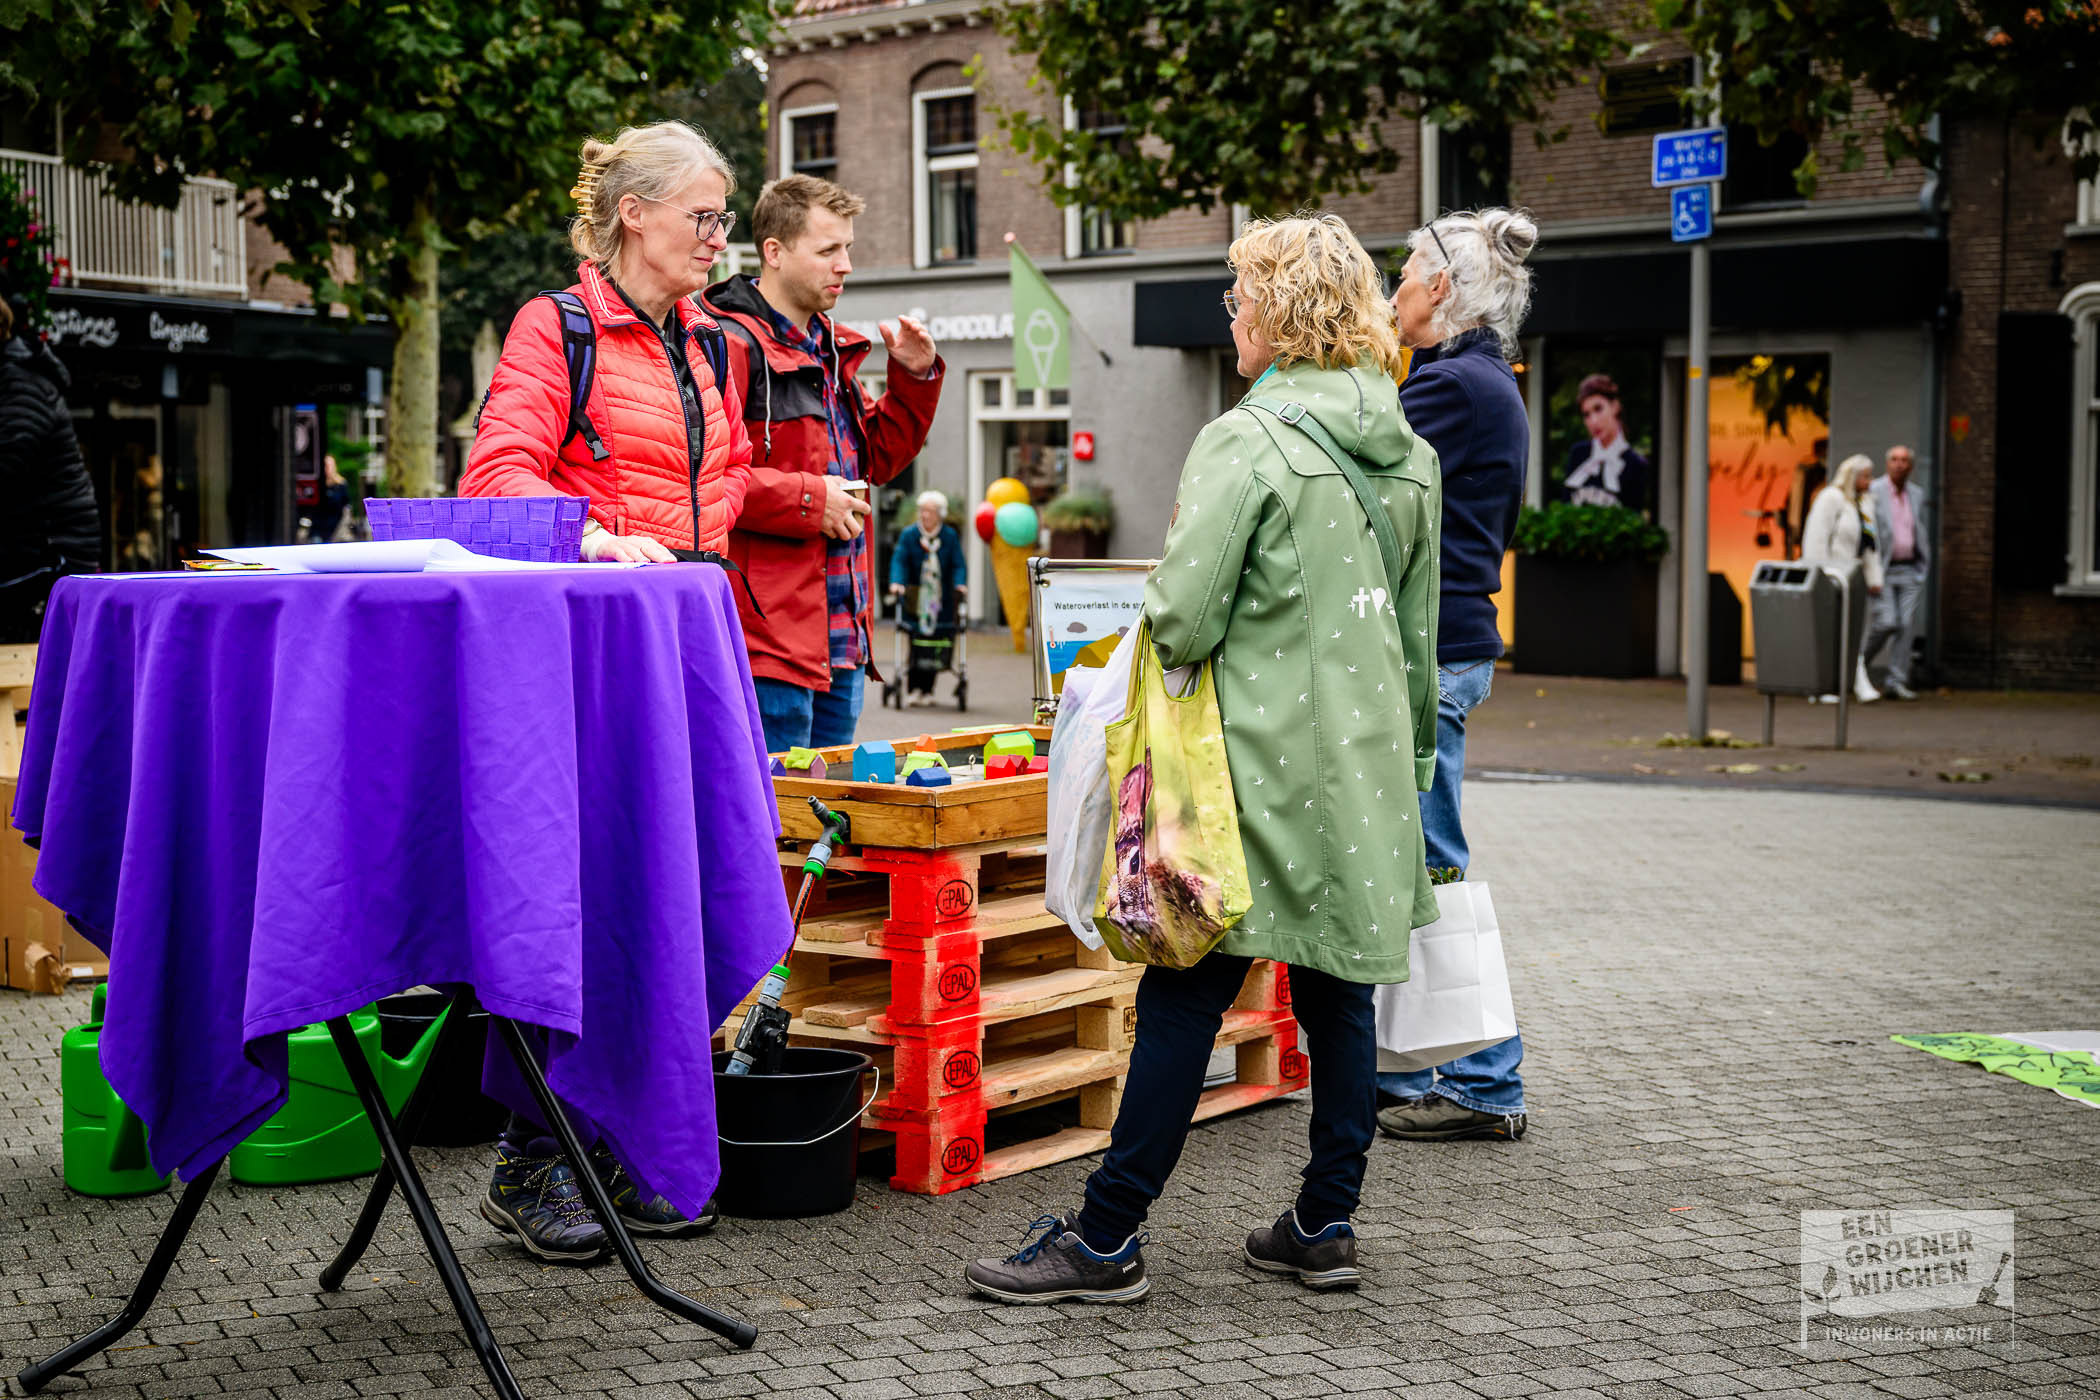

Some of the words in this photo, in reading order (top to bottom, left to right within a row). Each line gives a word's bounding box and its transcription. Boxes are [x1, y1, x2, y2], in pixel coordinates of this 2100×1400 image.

[930, 313, 1016, 341] CHOCOLA
[1054, 601, 1109, 610] Wateroverlast
[1112, 601, 1119, 609] in
[1121, 601, 1130, 609] de
[943, 887, 969, 910] EPAL
[945, 973, 971, 995] EPAL
[949, 1057, 975, 1081] EPAL
[948, 1144, 975, 1168] EPAL
